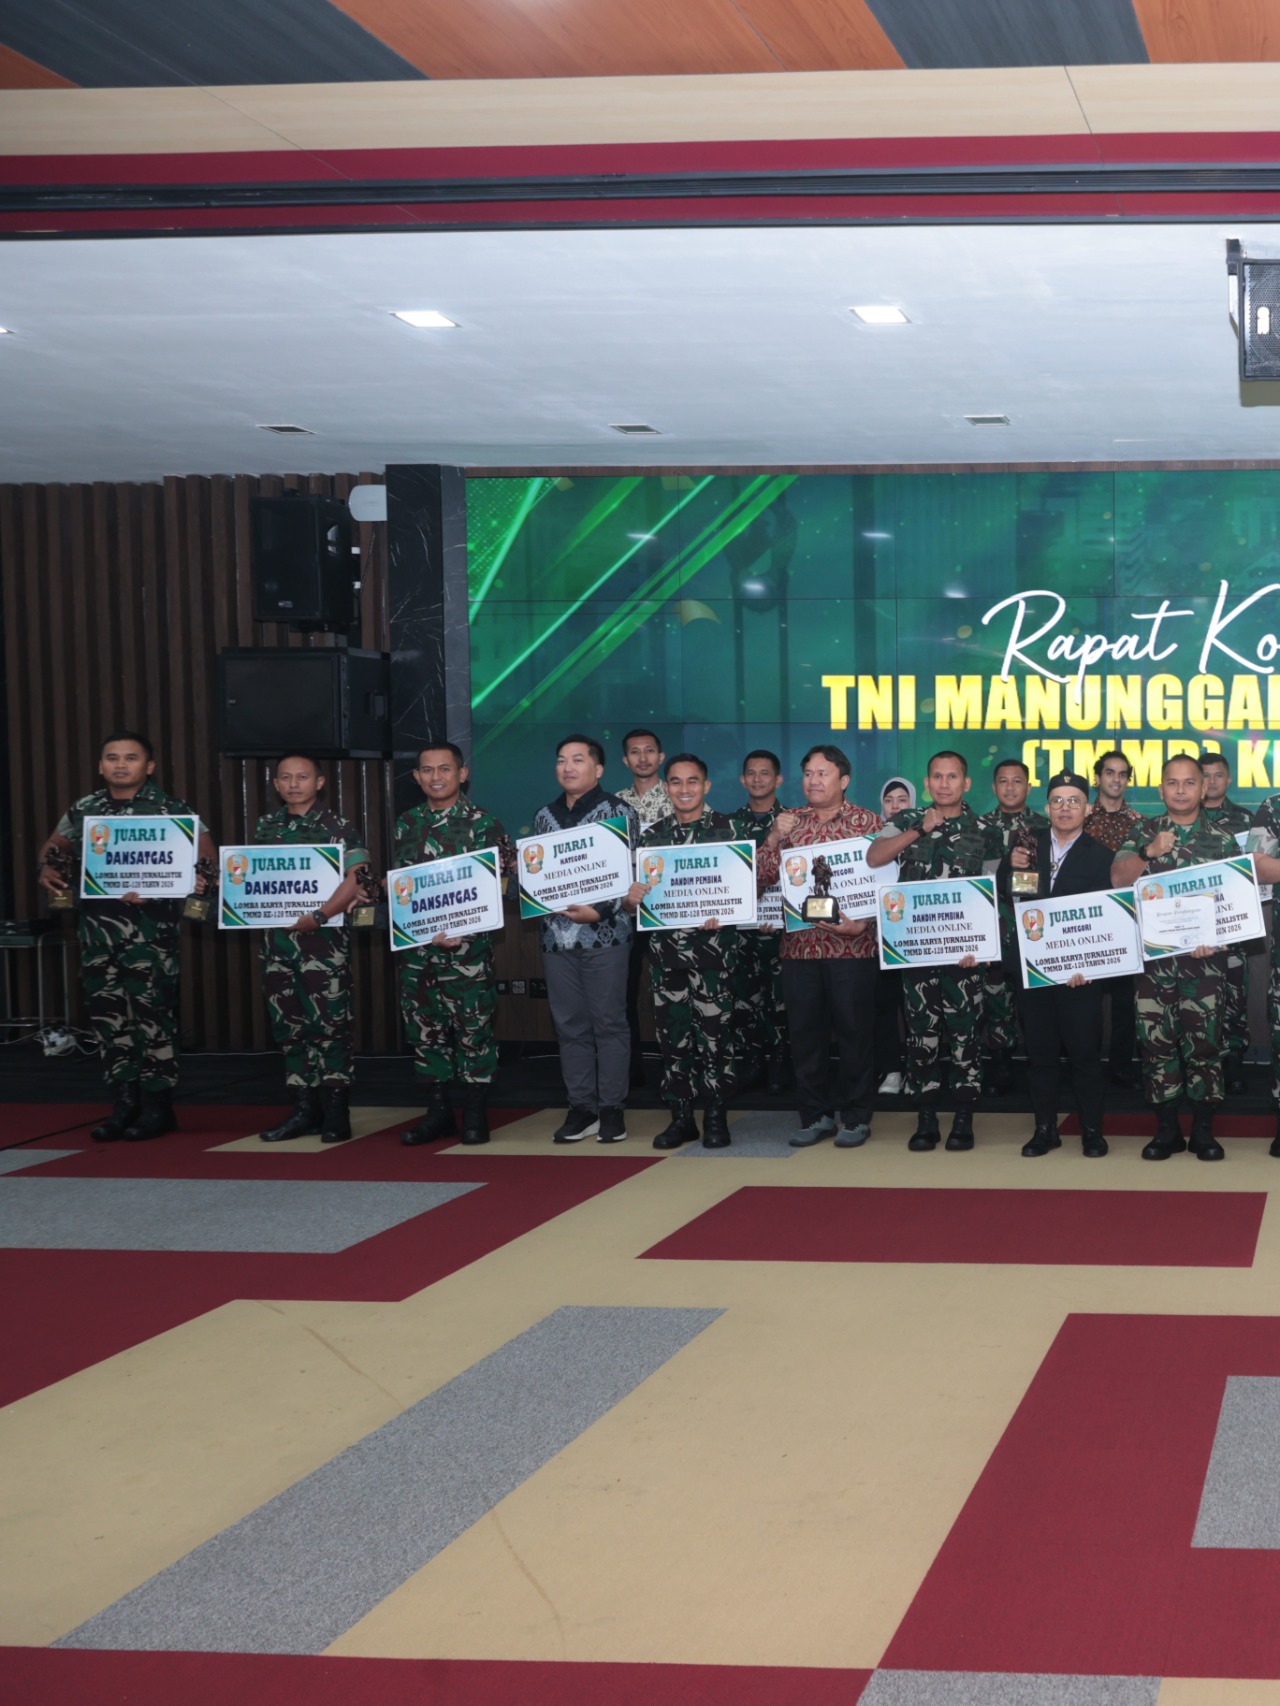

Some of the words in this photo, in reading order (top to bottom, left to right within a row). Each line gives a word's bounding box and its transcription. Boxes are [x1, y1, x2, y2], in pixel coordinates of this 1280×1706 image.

[981, 590, 1195, 705] Rapat
[821, 675, 916, 730] TNI
[114, 828, 158, 844] JUARA
[160, 828, 165, 841] I
[553, 838, 588, 858] JUARA
[589, 837, 594, 847] I
[106, 851, 173, 865] DANSATGAS
[560, 854, 588, 864] KATEGORI
[853, 851, 863, 861] II
[251, 858, 298, 874] JUARA
[300, 858, 311, 870] II
[544, 868, 573, 880] MEDIA
[574, 860, 607, 873] ONLINE
[674, 857, 710, 873] JUARA
[713, 857, 718, 867] I
[414, 869, 455, 893] JUARA
[456, 866, 472, 879] III
[533, 885, 557, 897] LOMBA
[558, 881, 578, 891] KARYA
[579, 872, 619, 889] JURNALISTIK
[671, 877, 694, 886] DANDIM
[696, 875, 722, 884] PEMBINA
[841, 875, 876, 887] ONLINE
[1169, 879, 1206, 897] JUARA
[1208, 875, 1223, 887] III
[245, 880, 318, 895] DANSATGAS
[580, 885, 600, 895] TAHUN
[663, 888, 693, 898] MEDIA
[695, 886, 730, 895] ONLINE
[412, 887, 478, 913] DANSATGAS
[651, 902, 676, 910] LOMBA
[677, 900, 698, 909] KARYA
[699, 898, 742, 909] JURNALISTIK
[912, 893, 948, 909] JUARA
[950, 892, 962, 903] II
[403, 918, 426, 929] LOMBA
[449, 905, 488, 922] JURNALISTIK
[660, 910, 678, 919] TMMD
[701, 908, 720, 916] TAHUN
[720, 907, 734, 915] 2026
[912, 913, 936, 923] DANDIM
[938, 912, 964, 921] PEMBINA
[1049, 908, 1086, 927] JUARA
[1089, 905, 1103, 918] III
[906, 926, 936, 934] MEDIA
[938, 923, 972, 932] ONLINE
[1062, 924, 1091, 934] KATEGORI
[1228, 924, 1242, 934] 2026
[894, 939, 919, 948] LOMBA
[920, 938, 942, 946] KARYA
[943, 934, 986, 945] JURNALISTIK
[1046, 939, 1076, 950] MEDIA
[1078, 933, 1113, 945] ONLINE
[903, 948, 922, 956] TMMD
[944, 945, 964, 954] TAHUN
[965, 944, 978, 952] 2026
[1035, 956, 1060, 966] LOMBA
[1061, 954, 1083, 963] KARYA
[1084, 947, 1127, 960] JURNALISTIK
[1043, 964, 1062, 973] TMMD
[1086, 959, 1105, 968] TAHUN
